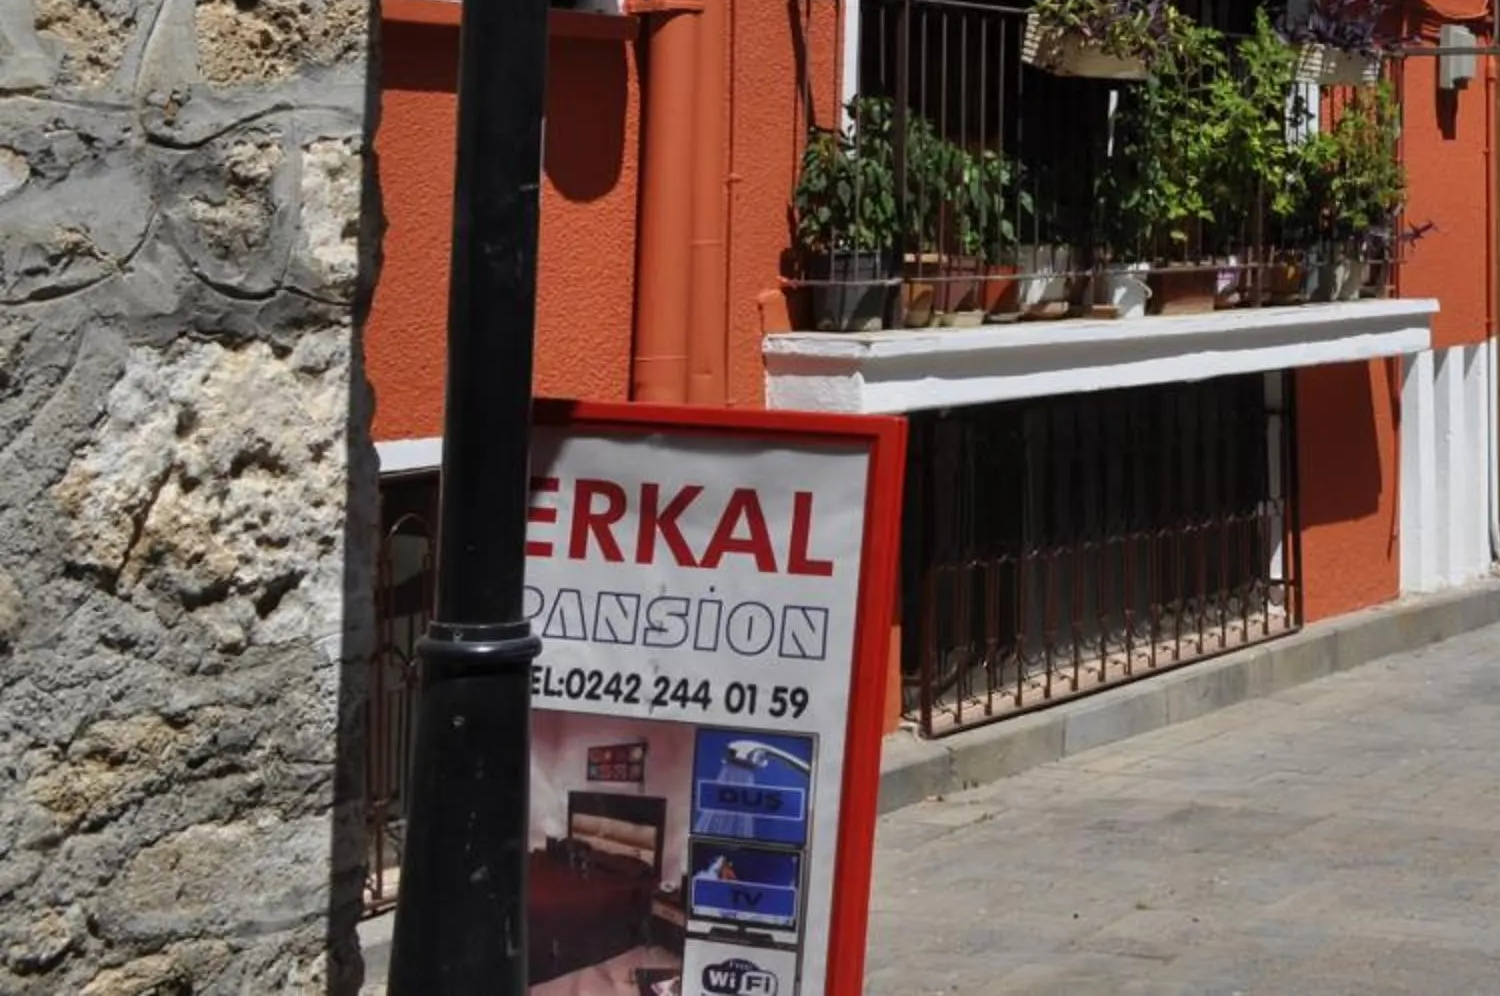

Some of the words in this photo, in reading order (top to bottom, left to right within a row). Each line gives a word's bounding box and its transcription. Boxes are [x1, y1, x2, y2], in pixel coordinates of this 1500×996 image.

[526, 477, 833, 577] ERKAL
[531, 666, 641, 704] EL:0242
[652, 675, 712, 710] 244
[725, 681, 757, 715] 01
[768, 686, 809, 718] 59
[731, 889, 763, 906] TV
